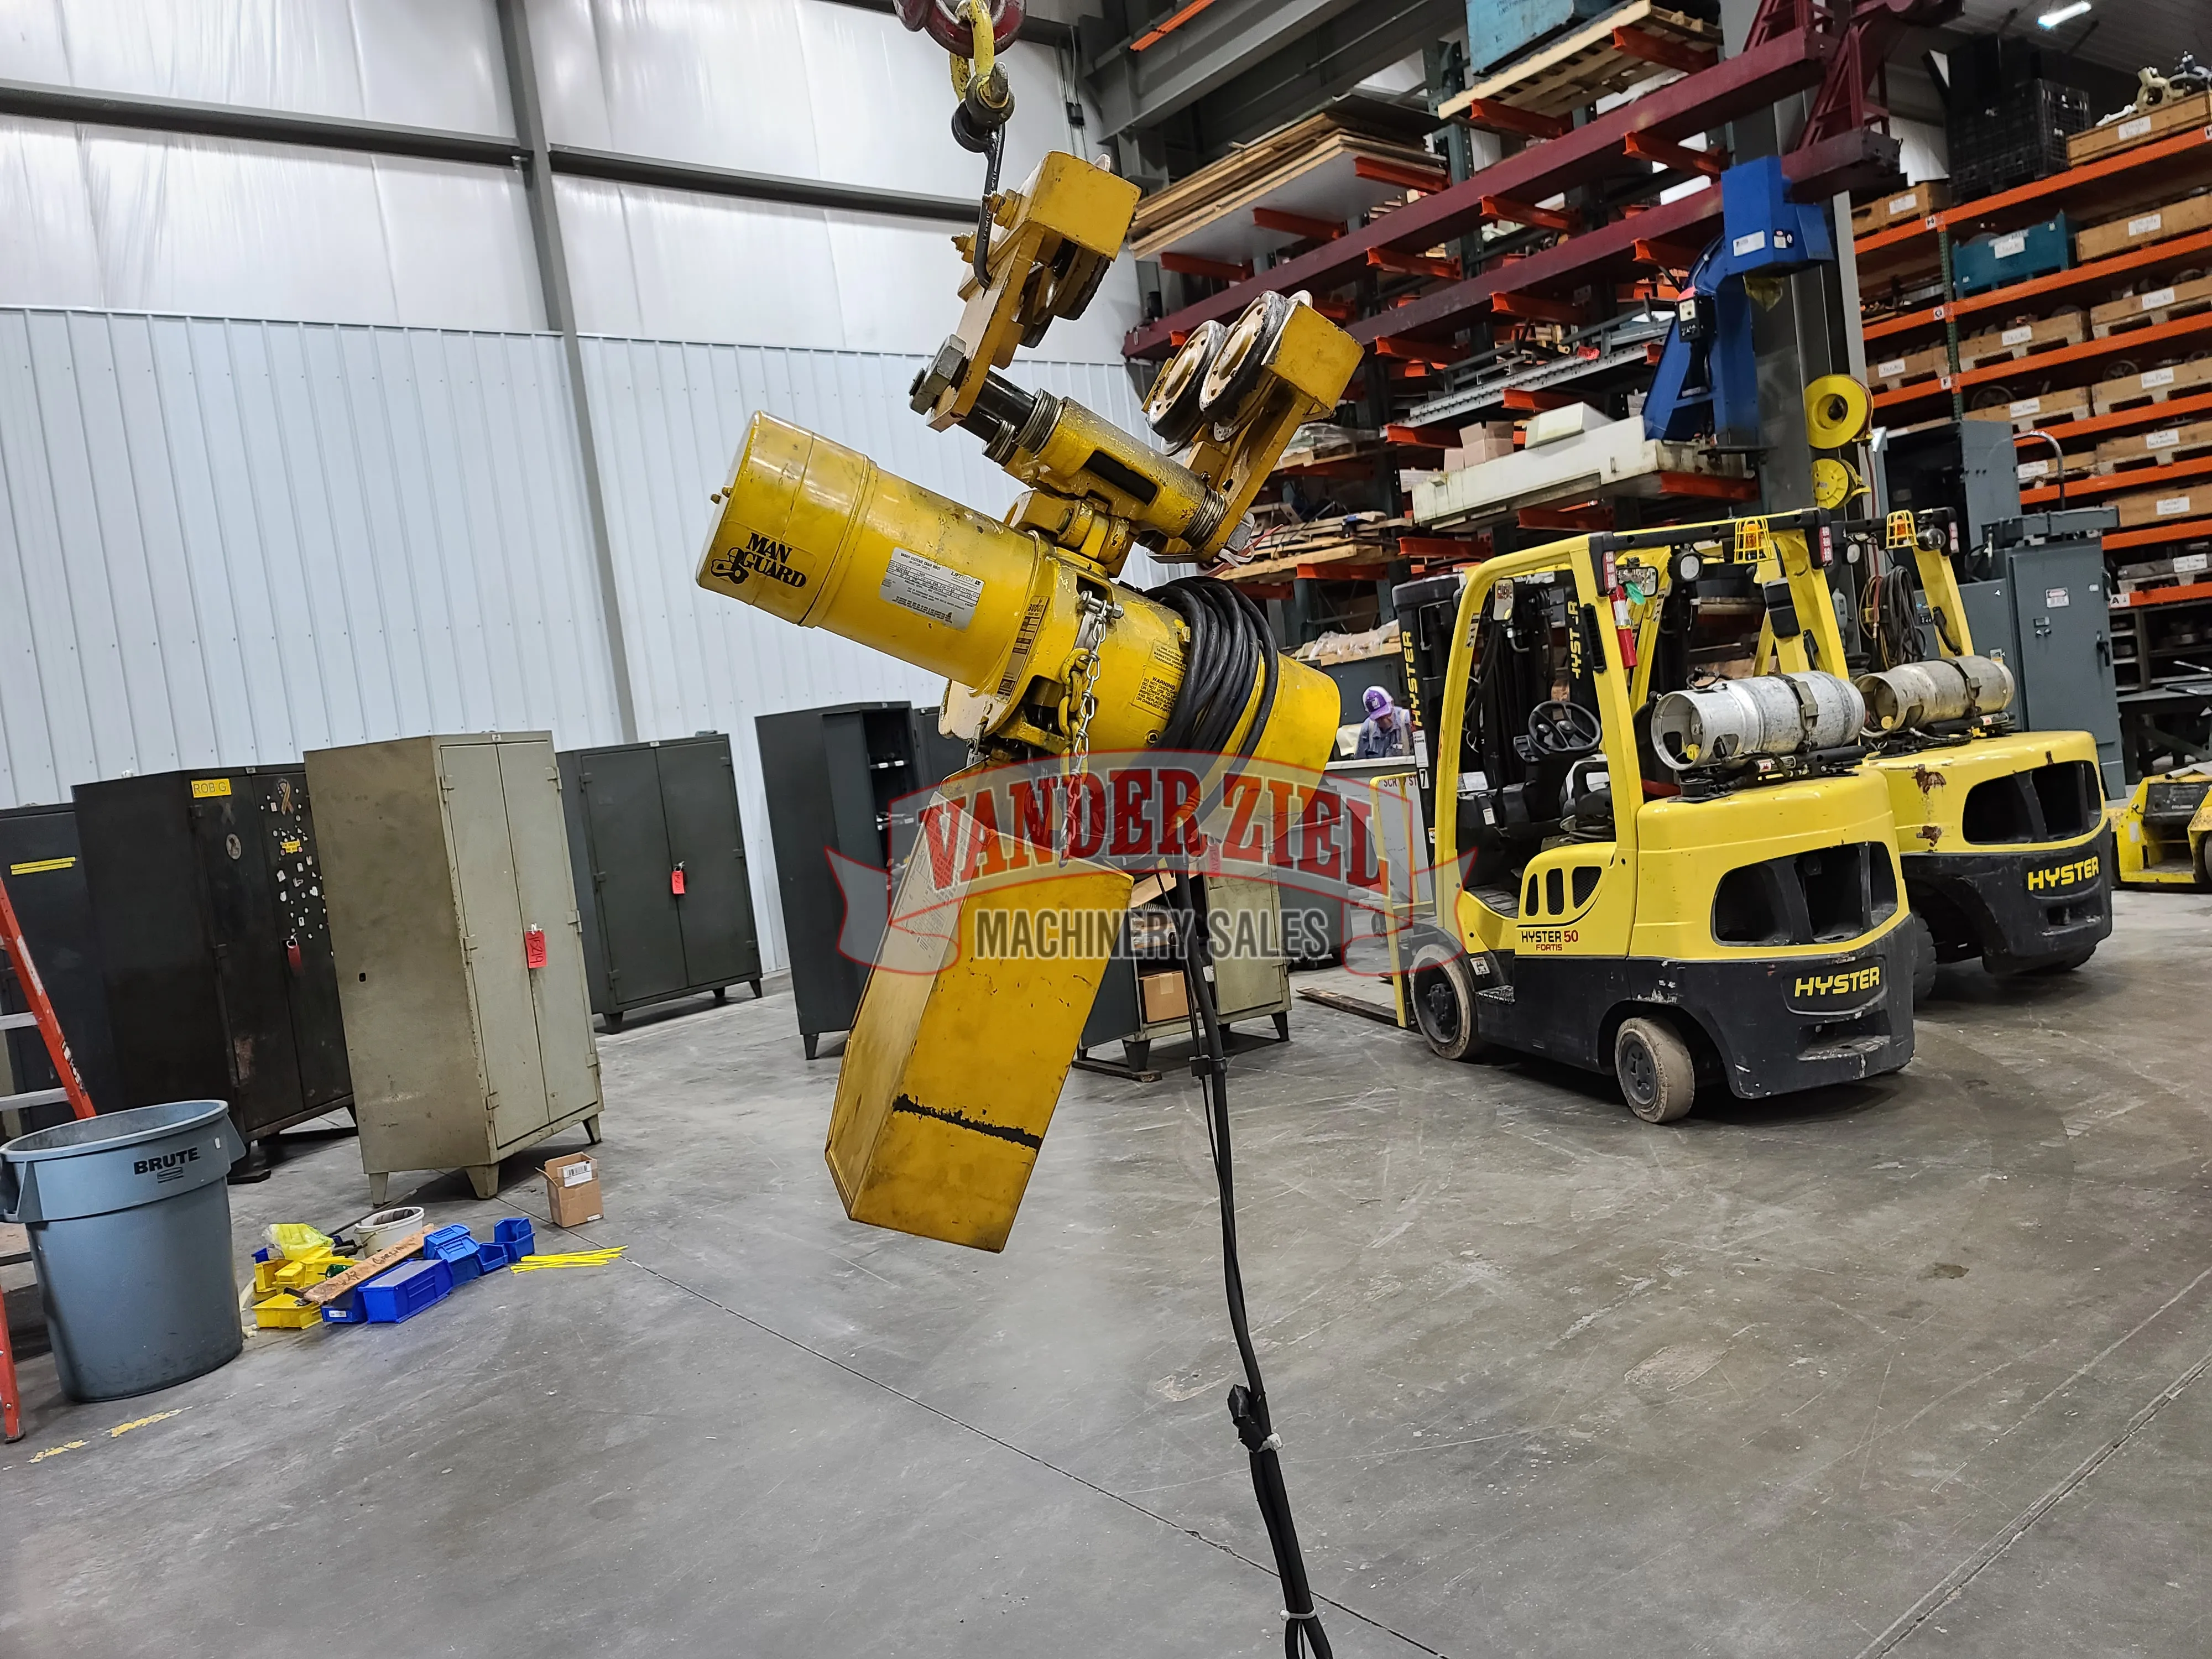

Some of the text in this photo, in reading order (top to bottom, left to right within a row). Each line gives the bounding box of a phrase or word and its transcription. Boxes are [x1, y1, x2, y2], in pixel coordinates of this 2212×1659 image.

[745, 532, 792, 564] MAN
[739, 551, 807, 588] GUARD
[1151, 676, 1176, 690] WARNING
[1402, 630, 1423, 727] HYSTER
[1139, 688, 1154, 698] INSPECT
[1146, 687, 1160, 696] LOWER
[1141, 698, 1160, 709] DAMAGED
[1145, 696, 1162, 706] REPLACE
[1420, 770, 1426, 787] 7
[194, 781, 226, 794] ROB G
[2028, 855, 2099, 891] HYSTER
[1521, 929, 1579, 943] HYSTER 50
[1794, 967, 1880, 997] HYSTER
[133, 1147, 198, 1175] BRUTE
